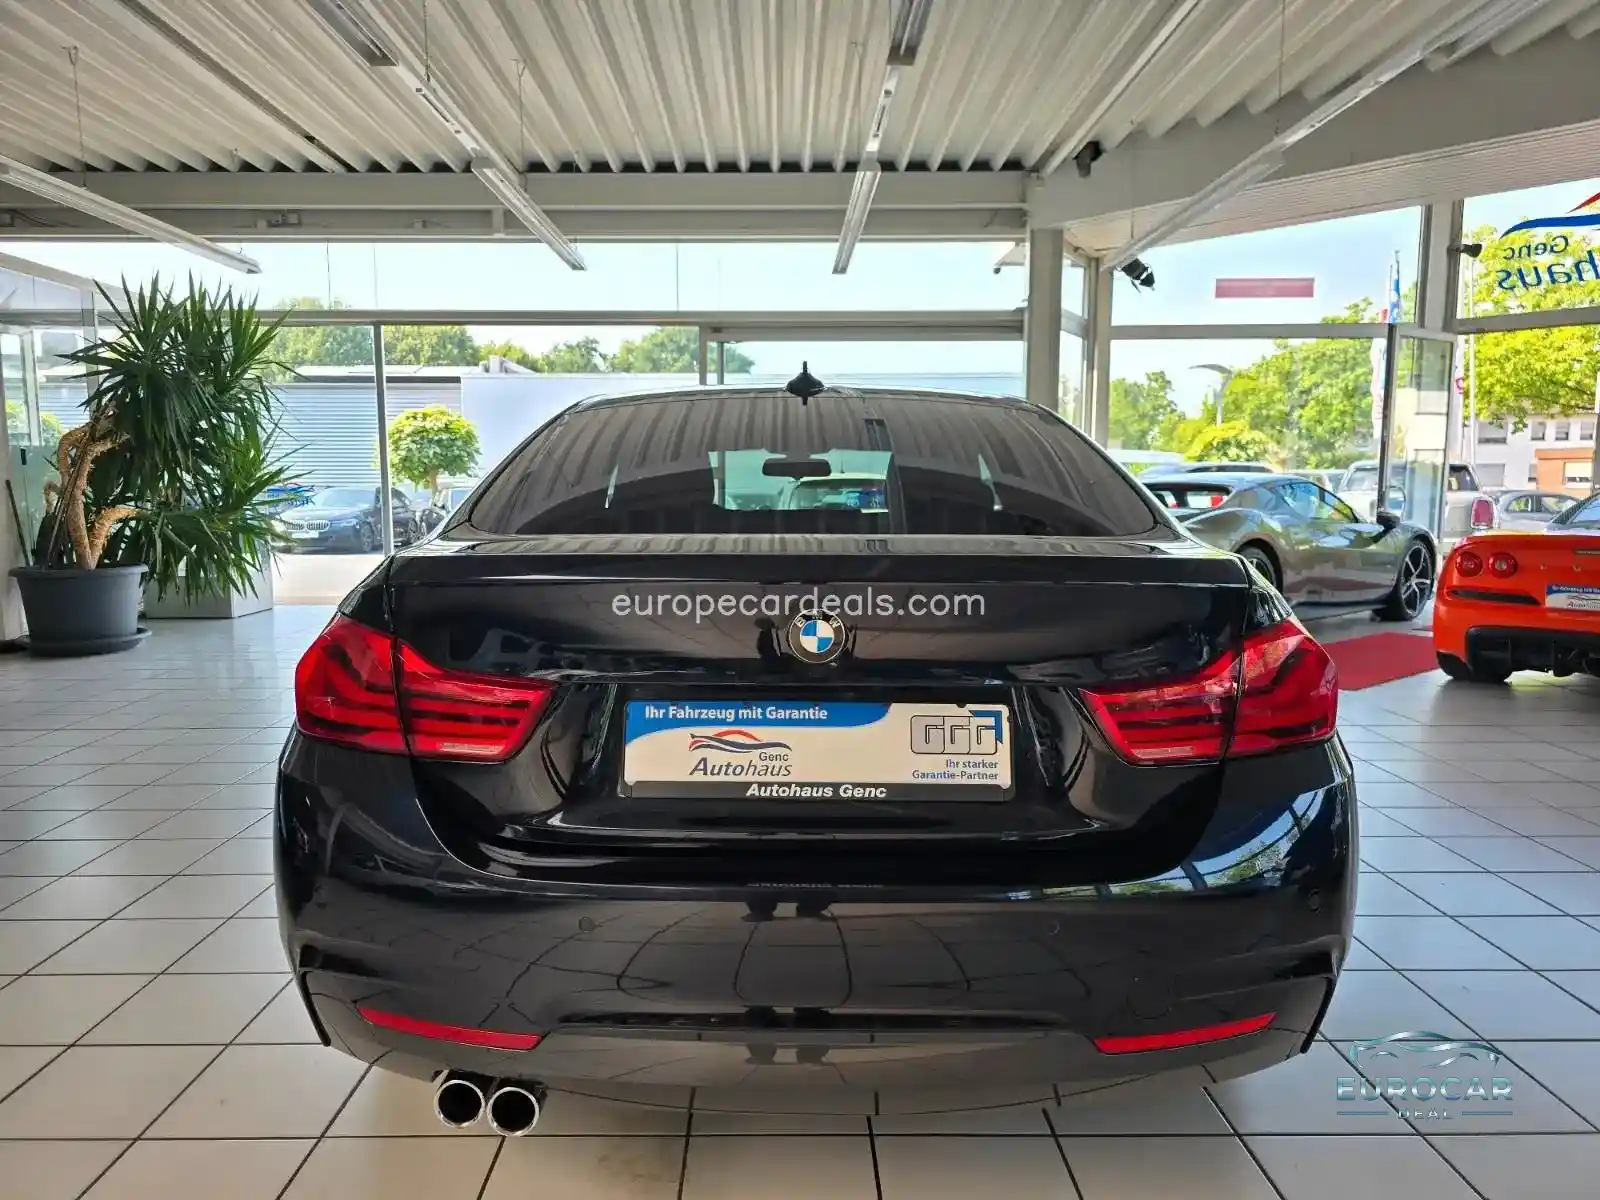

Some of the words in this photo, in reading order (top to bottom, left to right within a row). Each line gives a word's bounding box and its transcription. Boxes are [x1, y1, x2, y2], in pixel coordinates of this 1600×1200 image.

[645, 706, 665, 719] Ihr
[668, 706, 735, 721] Fahrzeug
[739, 706, 762, 719] mit
[766, 706, 828, 719] Garantie
[759, 752, 789, 762] Genc
[689, 756, 793, 777] Autohaus
[946, 759, 960, 768] Ihr
[962, 759, 999, 768] starker
[912, 770, 999, 780] Garantie-Partner
[746, 783, 833, 798] Autohaus
[839, 783, 887, 799] Genc
